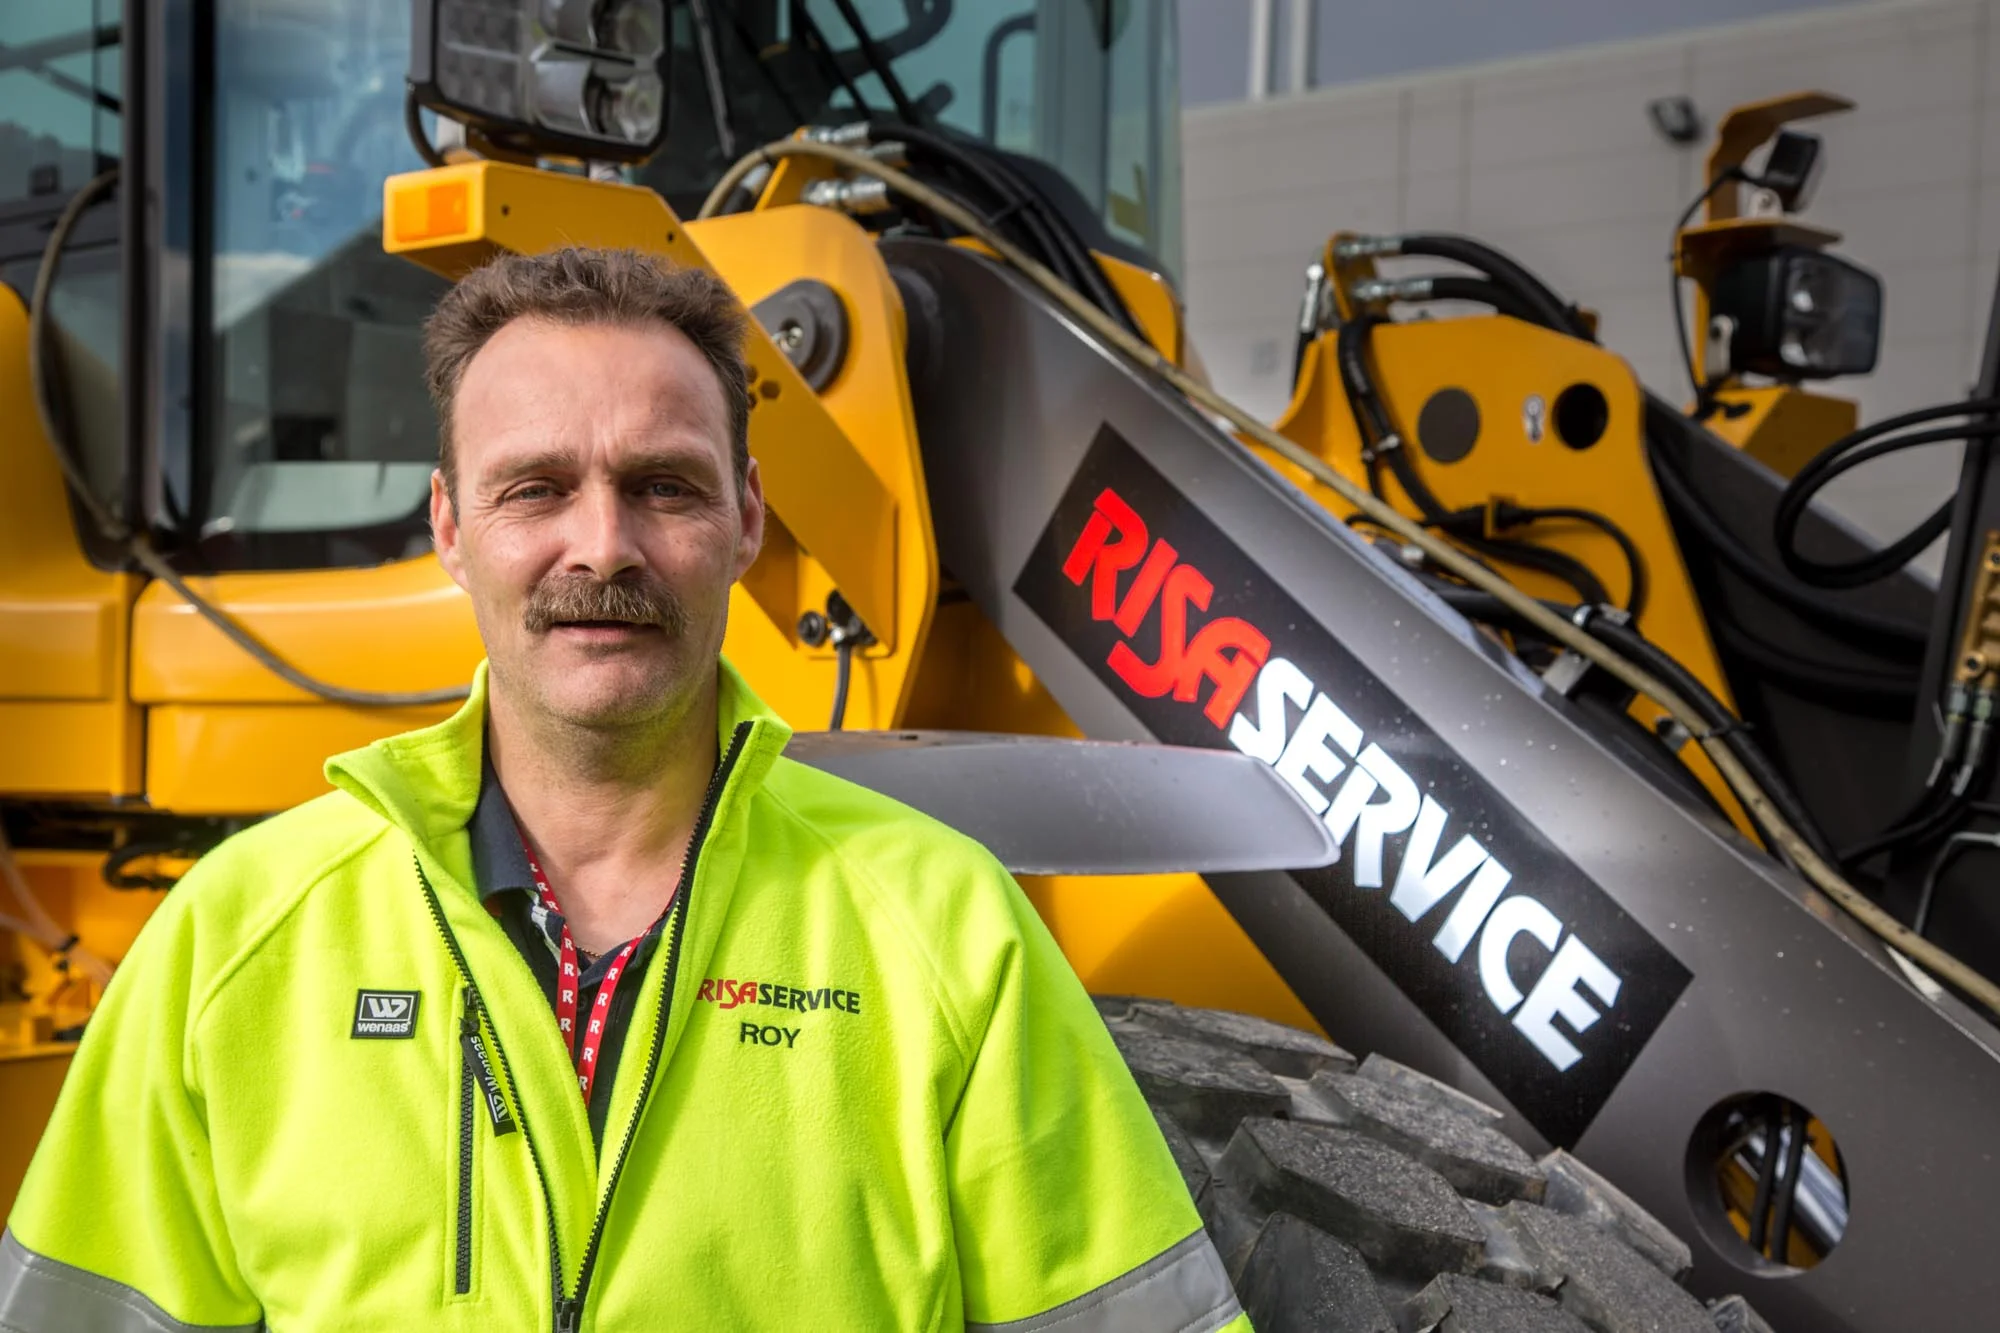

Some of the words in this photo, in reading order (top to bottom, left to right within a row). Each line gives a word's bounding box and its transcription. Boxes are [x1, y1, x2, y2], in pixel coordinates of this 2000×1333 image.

[564, 938, 573, 951] R
[564, 963, 574, 976] R
[607, 968, 618, 980] R
[562, 990, 573, 1004] R
[598, 993, 608, 1006] R
[561, 1018, 571, 1032] R
[590, 1020, 600, 1034] R
[740, 1022, 801, 1048] ROY
[583, 1047, 593, 1062] R
